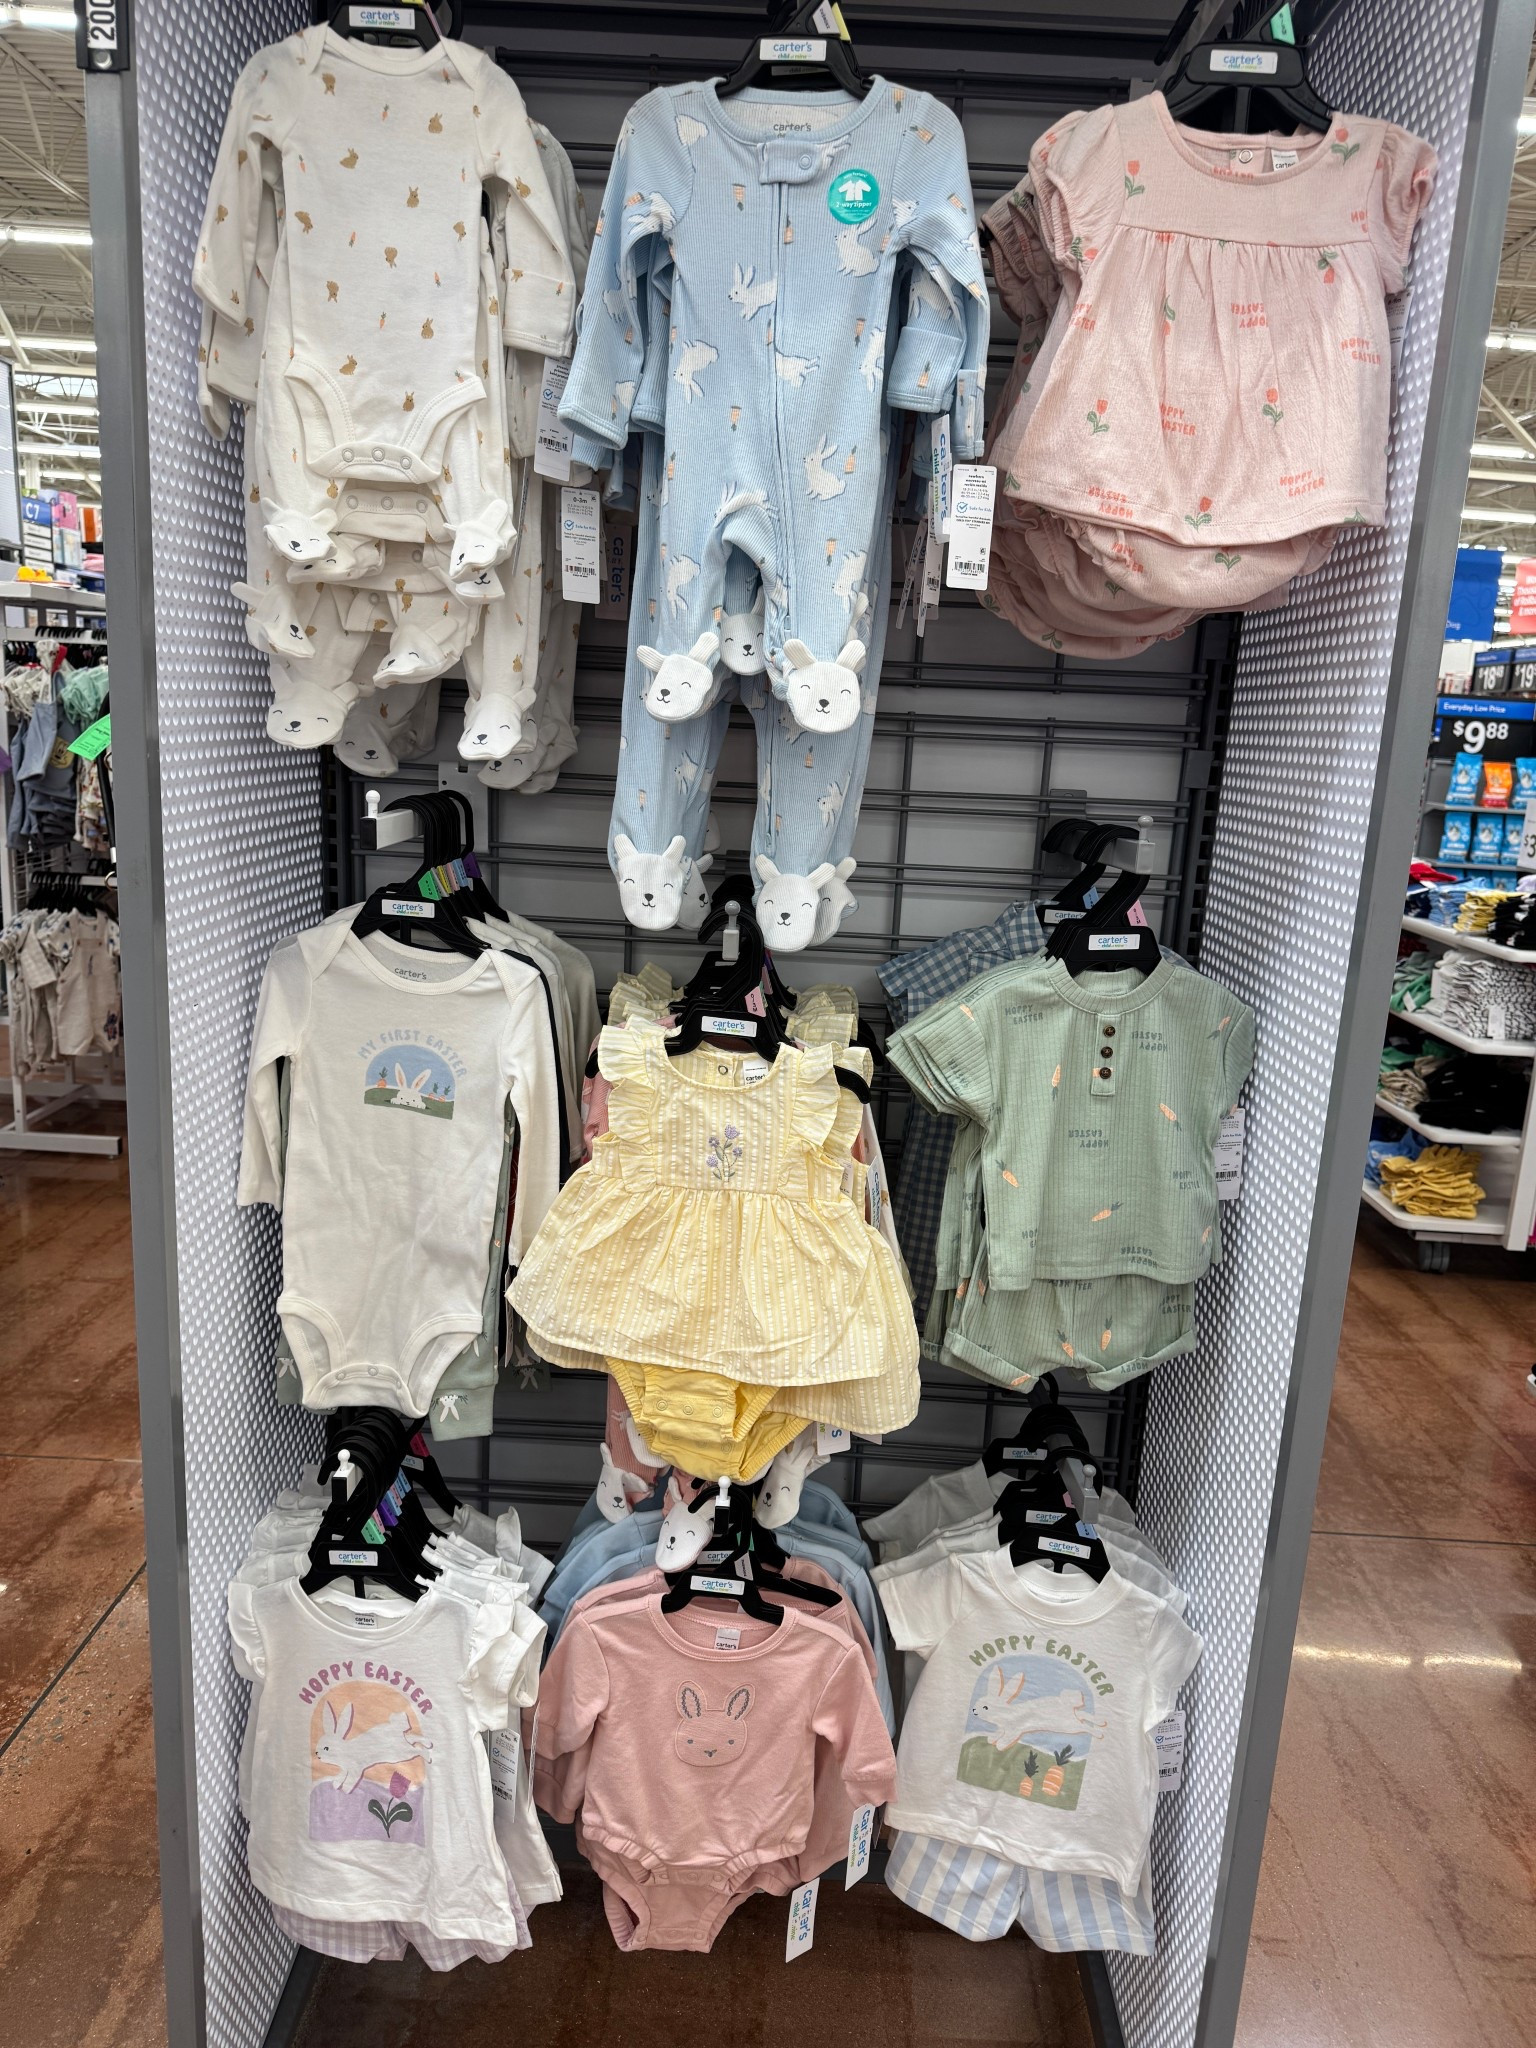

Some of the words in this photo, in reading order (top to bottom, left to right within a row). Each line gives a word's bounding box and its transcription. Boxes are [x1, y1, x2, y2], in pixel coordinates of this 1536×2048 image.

[360, 10, 400, 21] carter's
[773, 41, 813, 52] carter's
[1223, 54, 1263, 65] carter's
[773, 122, 812, 132] carter's
[1279, 469, 1313, 487] HOPPY
[1288, 475, 1326, 498] EASTER
[25, 502, 40, 520] C7
[1443, 702, 1474, 713] Everyday
[1474, 704, 1488, 712] Low
[1488, 705, 1506, 714] Price
[392, 902, 424, 912] carter's
[1097, 936, 1128, 944] carter's
[394, 967, 427, 980] carter's
[1004, 1004, 1034, 1016] HOPPY
[1013, 1012, 1044, 1025] EASTER
[712, 1020, 745, 1030] carter's
[357, 1039, 377, 1060] MY
[379, 1029, 421, 1044] FIRST
[426, 1034, 467, 1078] EASTER
[1068, 1129, 1103, 1138] EASTER
[1080, 1139, 1109, 1149] HOPPY
[1035, 1512, 1063, 1521] carter'
[1048, 1540, 1080, 1553] carter's
[338, 1552, 368, 1561] carter's
[701, 1580, 733, 1589] carter's
[355, 1616, 375, 1624] carter's
[716, 1641, 737, 1650] carter's
[969, 1635, 1035, 1667] HOPPY
[1046, 1639, 1115, 1697] EASTER
[299, 1660, 353, 1705] HOPPY
[364, 1661, 433, 1715] EASTER
[857, 1809, 871, 1868] carer's
